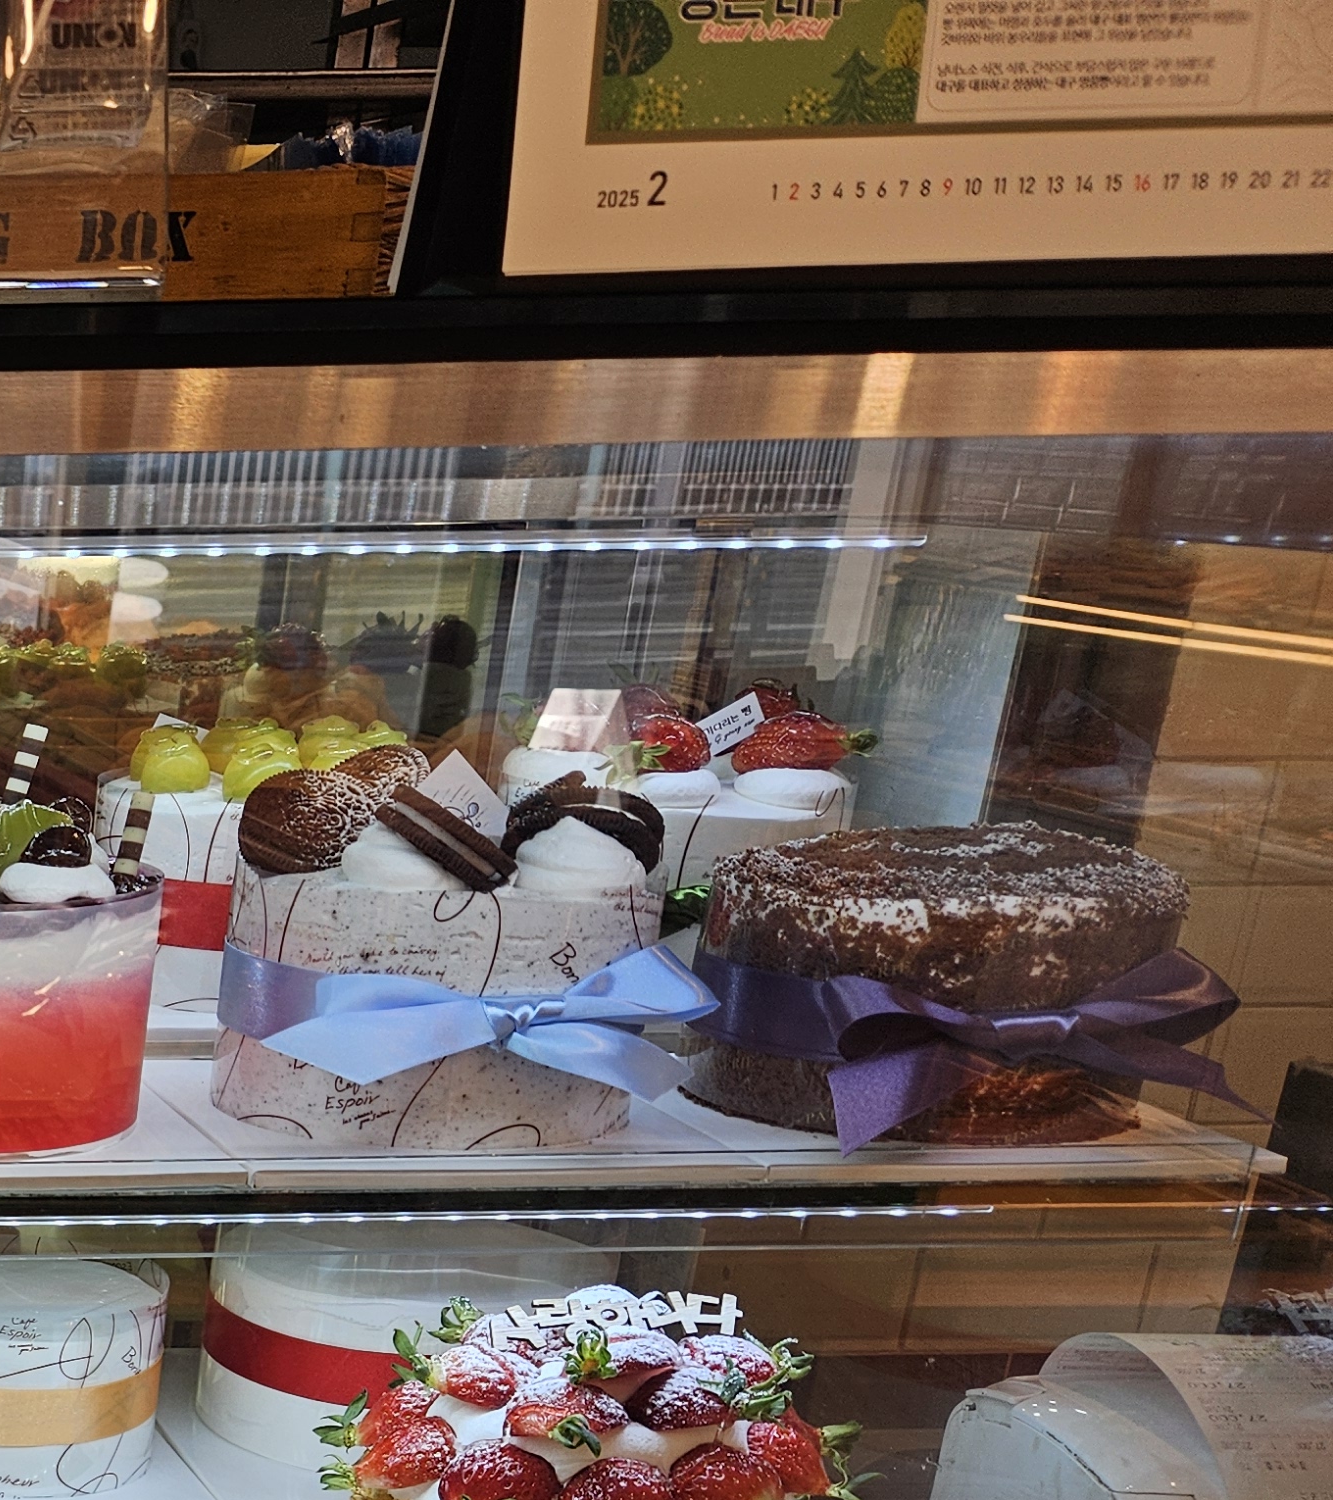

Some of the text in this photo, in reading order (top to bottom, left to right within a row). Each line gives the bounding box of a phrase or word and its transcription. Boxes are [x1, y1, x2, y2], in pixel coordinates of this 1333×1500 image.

[597, 170, 669, 209] 2025 2
[771, 169, 1332, 201] 1 2 3 4 5 6 7 8 9 10 11 12 13 14 15 16 17 18 19 20 21 22
[74, 209, 198, 264] BOX
[324, 1089, 381, 1115] Espoir
